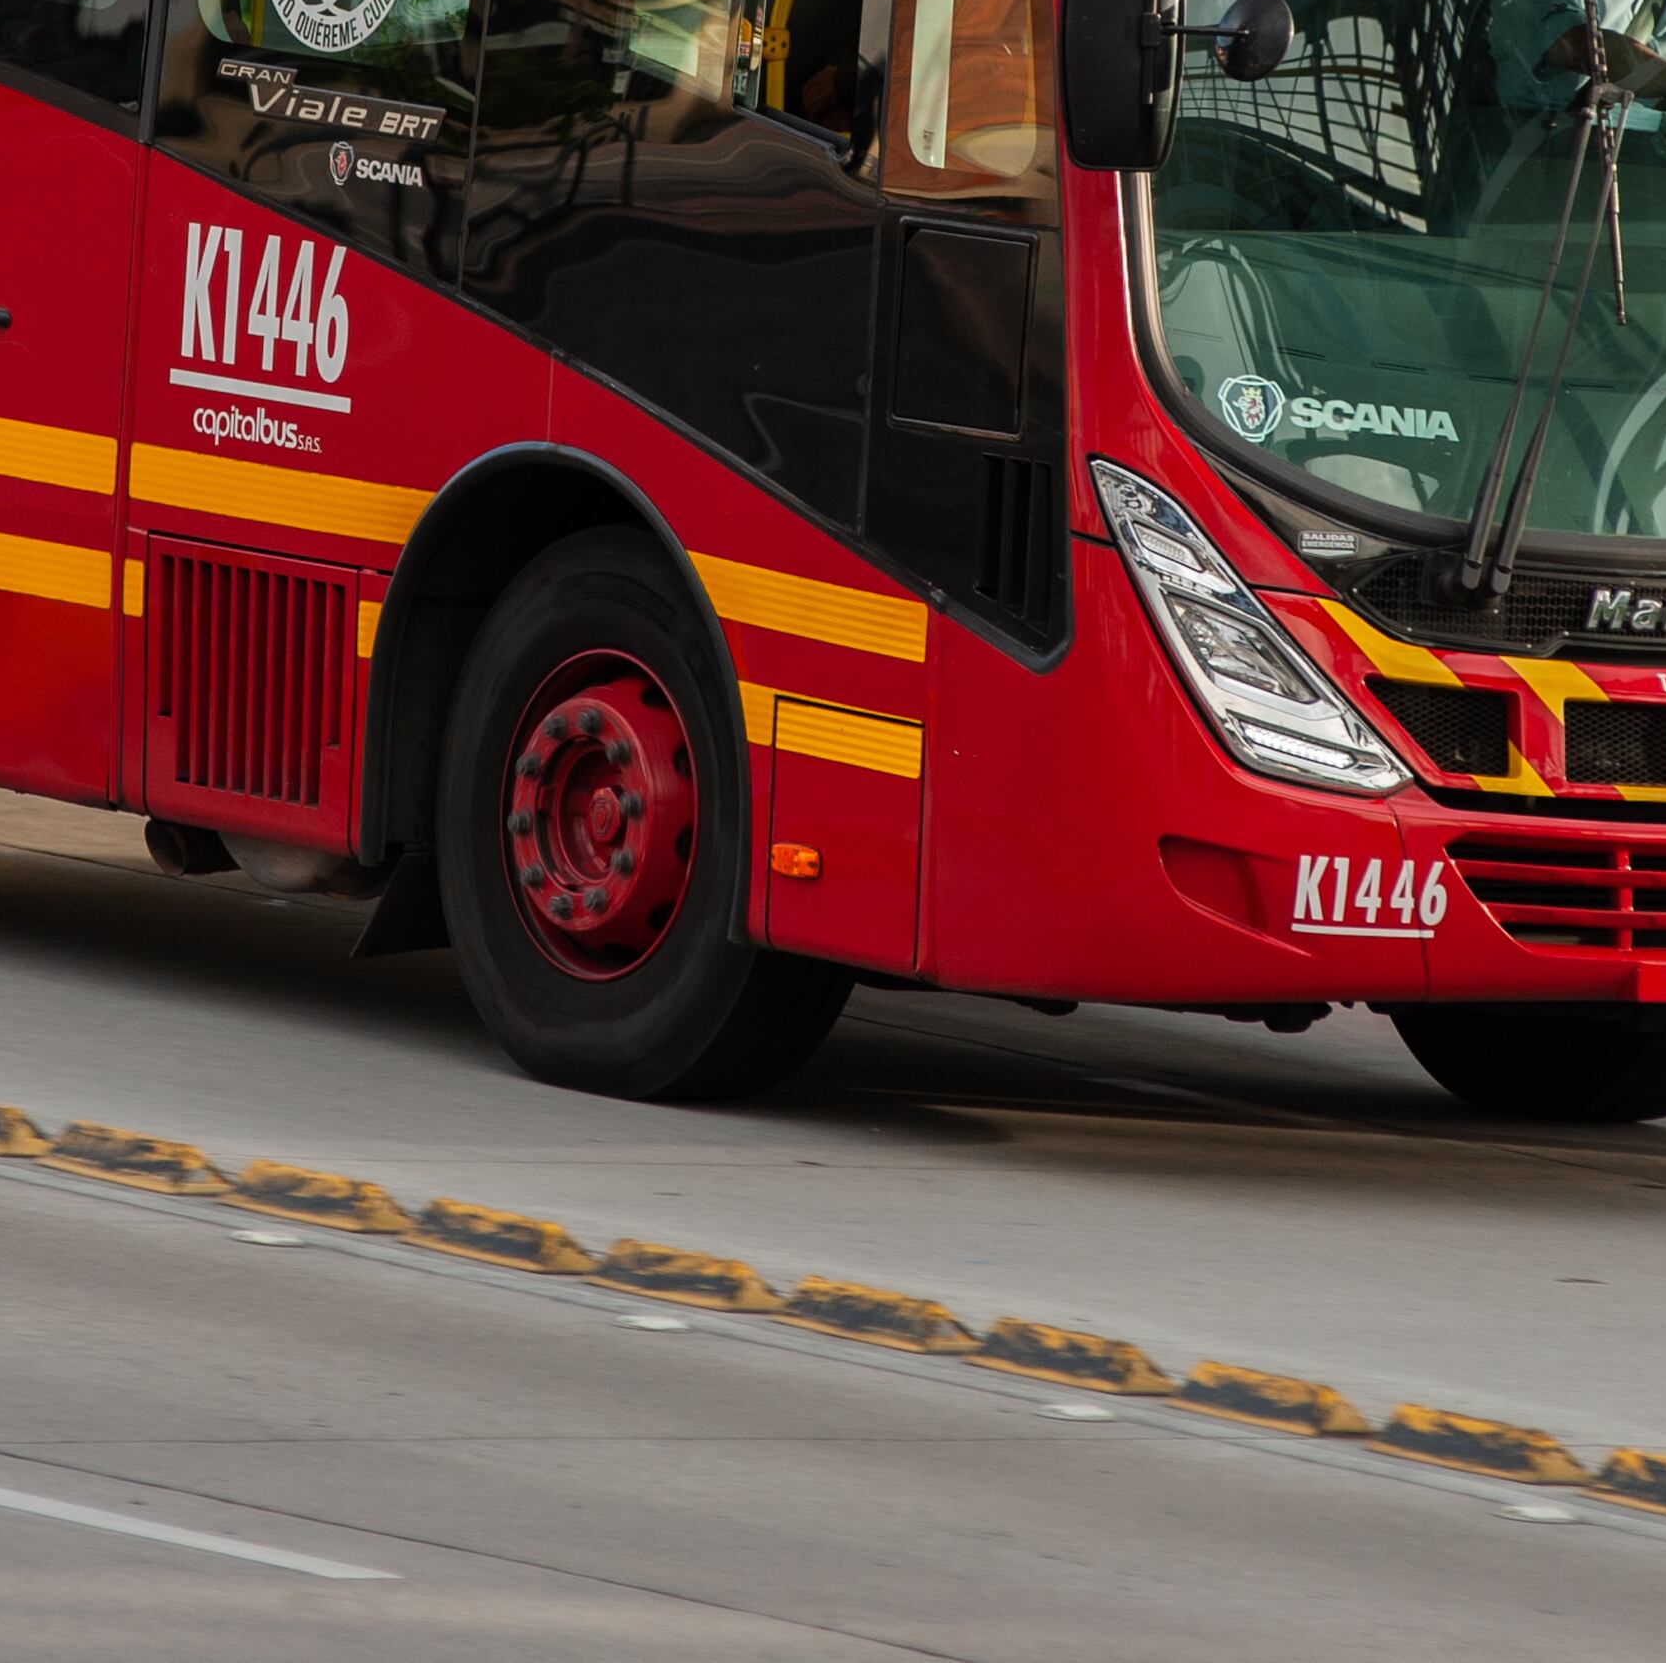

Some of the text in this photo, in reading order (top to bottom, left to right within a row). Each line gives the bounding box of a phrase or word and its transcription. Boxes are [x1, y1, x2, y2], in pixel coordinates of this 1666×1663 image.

[295, 11, 364, 48] QUIÉREME,
[221, 63, 292, 84] GRAN
[250, 83, 439, 139] Viale BRT
[356, 158, 423, 187] SCANIA
[181, 222, 349, 384] K1446
[192, 405, 298, 448] capitalbus
[1290, 396, 1460, 442] SCANIA
[1302, 532, 1355, 542] SALIDAS
[1293, 855, 1448, 927] K1446
